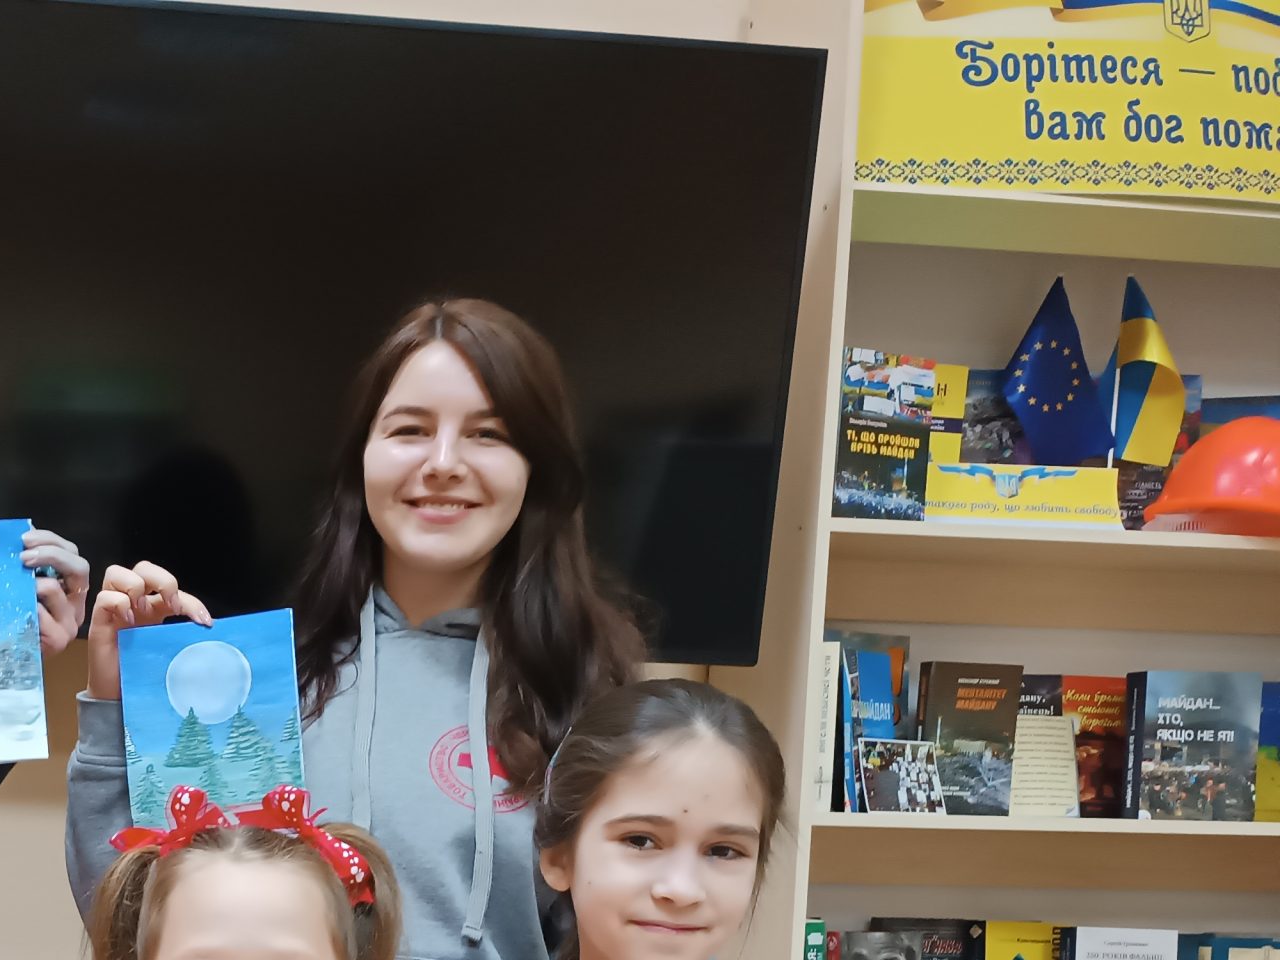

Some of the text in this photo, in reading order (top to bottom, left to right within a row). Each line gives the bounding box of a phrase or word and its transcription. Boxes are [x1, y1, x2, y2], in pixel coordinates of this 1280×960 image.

[955, 39, 1163, 93] Борітеся
[1024, 98, 1106, 141] вам
[1124, 98, 1185, 144] бог
[880, 446, 915, 459] МАЙДАН
[1157, 713, 1184, 727] ХТО,
[1156, 728, 1194, 743] ЯКЩО
[1197, 730, 1214, 742] НЕ
